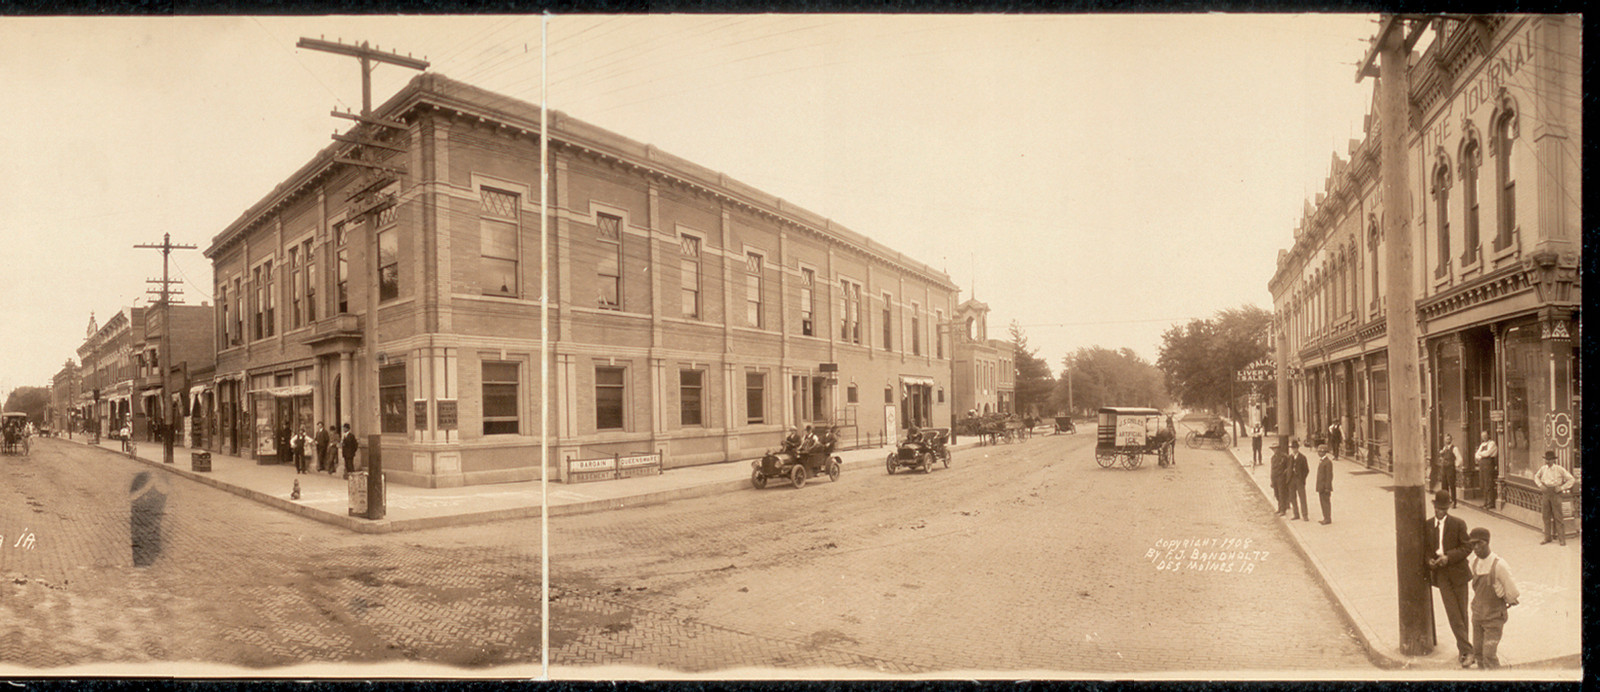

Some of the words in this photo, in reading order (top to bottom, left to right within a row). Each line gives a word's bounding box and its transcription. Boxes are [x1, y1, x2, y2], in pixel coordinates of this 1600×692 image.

[1424, 110, 1451, 156] THE
[1460, 30, 1534, 120] JOURNAL
[1249, 359, 1277, 370] PALACE
[580, 460, 607, 468] BARGAIN
